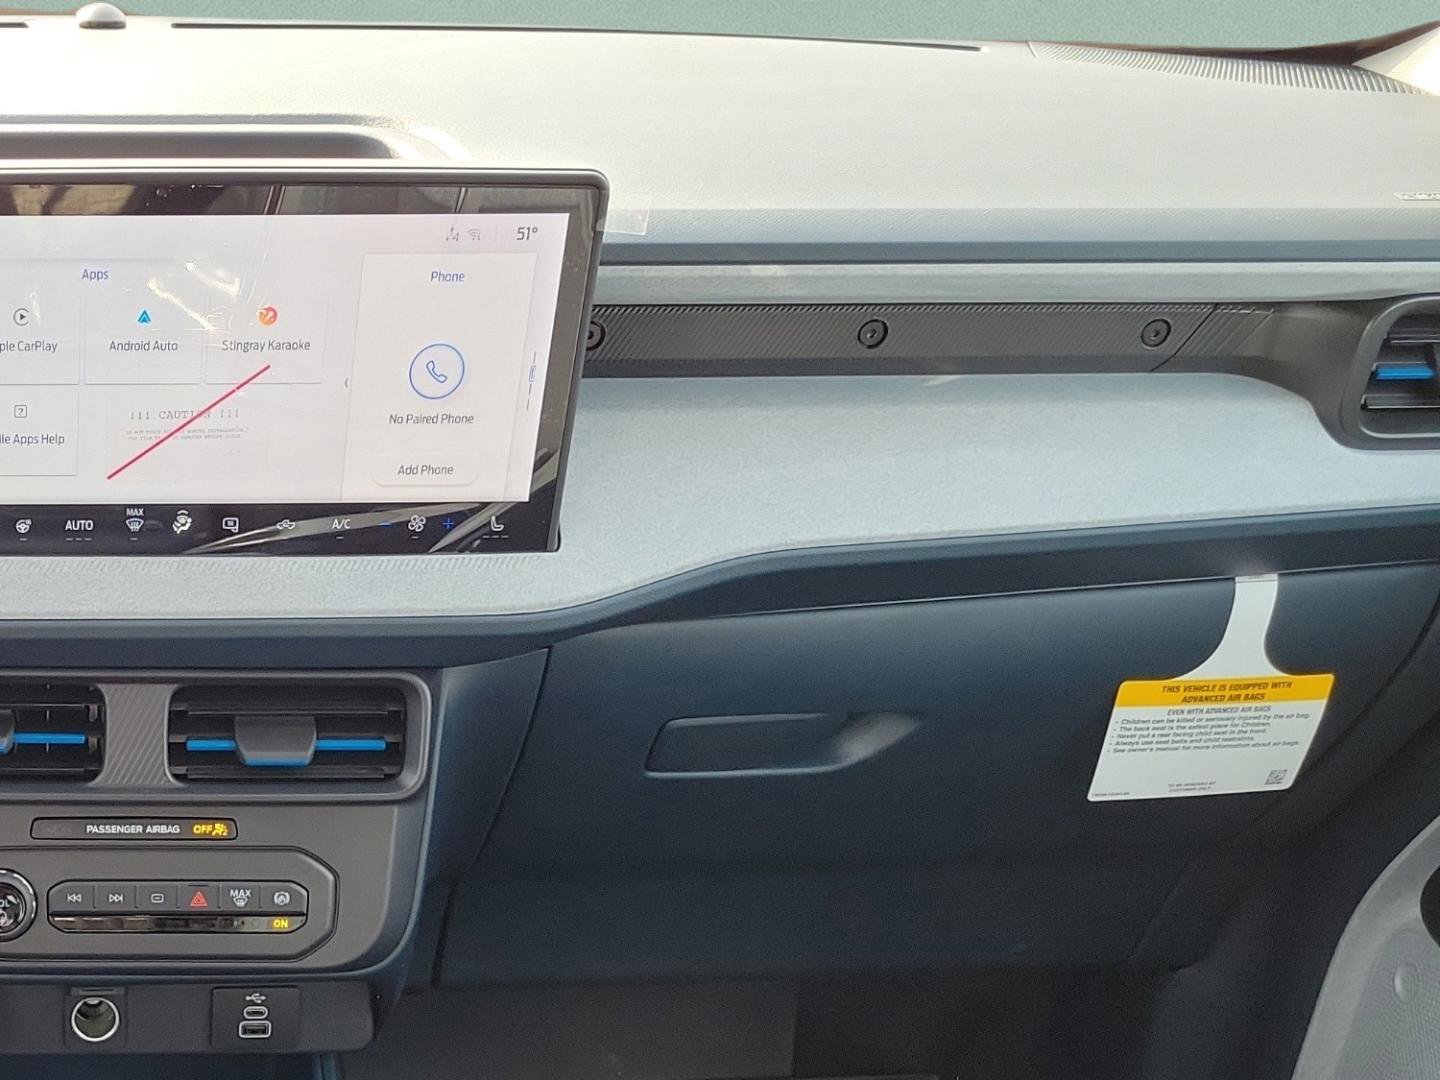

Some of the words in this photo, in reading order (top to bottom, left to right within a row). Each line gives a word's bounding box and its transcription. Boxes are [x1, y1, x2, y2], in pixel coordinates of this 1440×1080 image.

[515, 226, 539, 242] 51°
[81, 267, 109, 282] Apps
[430, 270, 466, 283] Phone
[18, 340, 58, 353] CarPlay
[108, 340, 151, 352] Android
[152, 340, 178, 352] Auto
[221, 339, 266, 353] Stingray
[268, 339, 311, 351] Karaoke
[388, 413, 404, 425] No
[405, 413, 439, 425] Paired
[440, 413, 474, 425] Phone
[13, 433, 40, 447] Apps
[41, 433, 65, 446] Help
[397, 464, 419, 476] Add
[420, 464, 454, 476] Phone
[125, 507, 145, 517] MAX
[64, 519, 94, 532] AUTO
[331, 518, 351, 530] A/C
[1161, 685, 1181, 694] THIS
[1183, 684, 1217, 693] VEHICLE
[1217, 683, 1227, 692] IS
[1228, 682, 1269, 692] EQUIPPED
[1270, 681, 1293, 690] WITH
[1180, 694, 1226, 704] ADVANCED
[1227, 693, 1242, 702] AIR
[1243, 692, 1265, 701] BAGS
[1166, 708, 1185, 716] EVEN
[1186, 707, 1204, 716] WITH
[1205, 706, 1240, 715] ADVANCED
[1240, 705, 1252, 713] AIR
[1252, 705, 1272, 713] BAGS
[85, 824, 143, 834] PASSENGER
[145, 824, 181, 834] AIRBAG
[192, 824, 213, 834] OFF
[229, 888, 252, 897] MAX
[272, 918, 289, 929] ON
